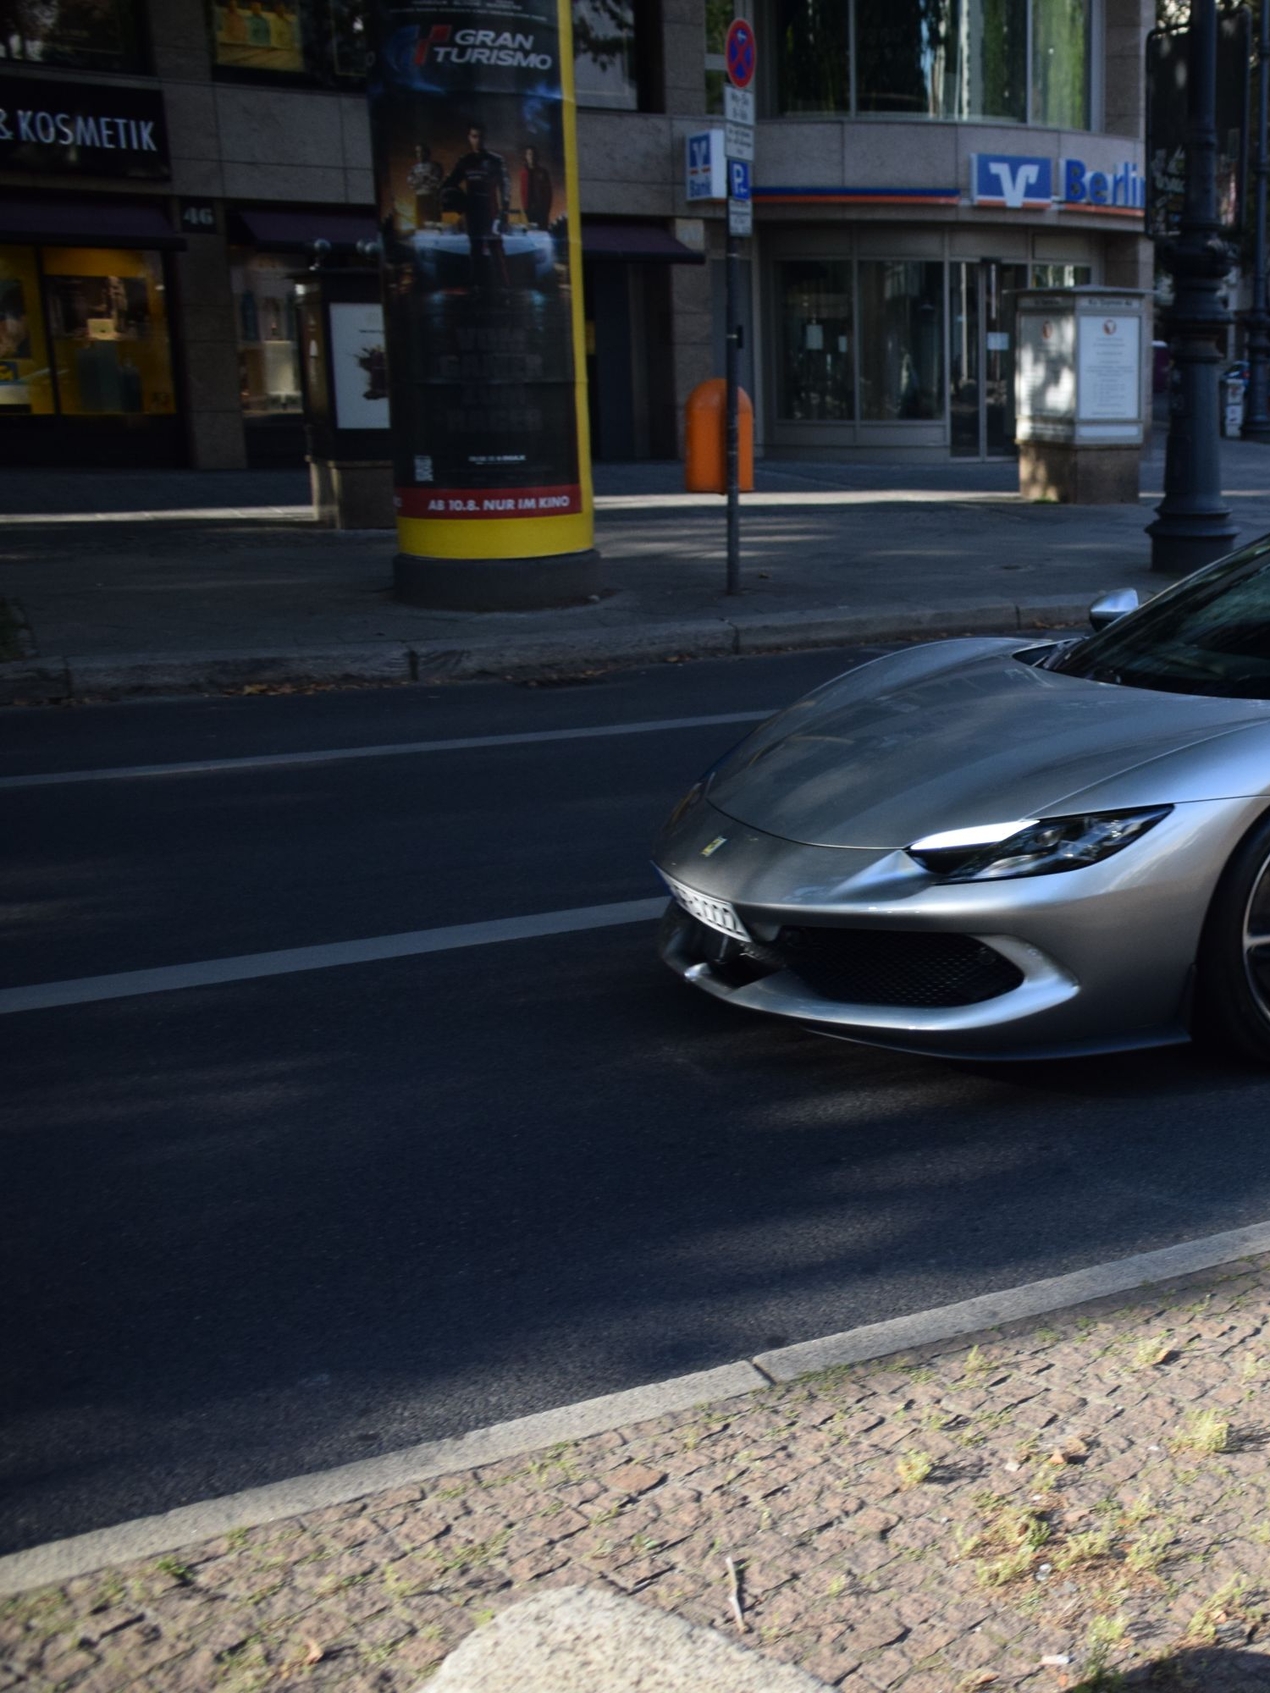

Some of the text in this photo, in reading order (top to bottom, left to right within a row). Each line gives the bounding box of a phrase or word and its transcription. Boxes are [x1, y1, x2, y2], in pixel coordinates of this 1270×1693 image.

[454, 28, 535, 50] GRAN
[433, 46, 553, 71] TURISMO
[16, 108, 158, 152] KOSMETIK
[183, 206, 215, 226] 46
[428, 495, 571, 511] AB 10.8. NUR IM KINO
